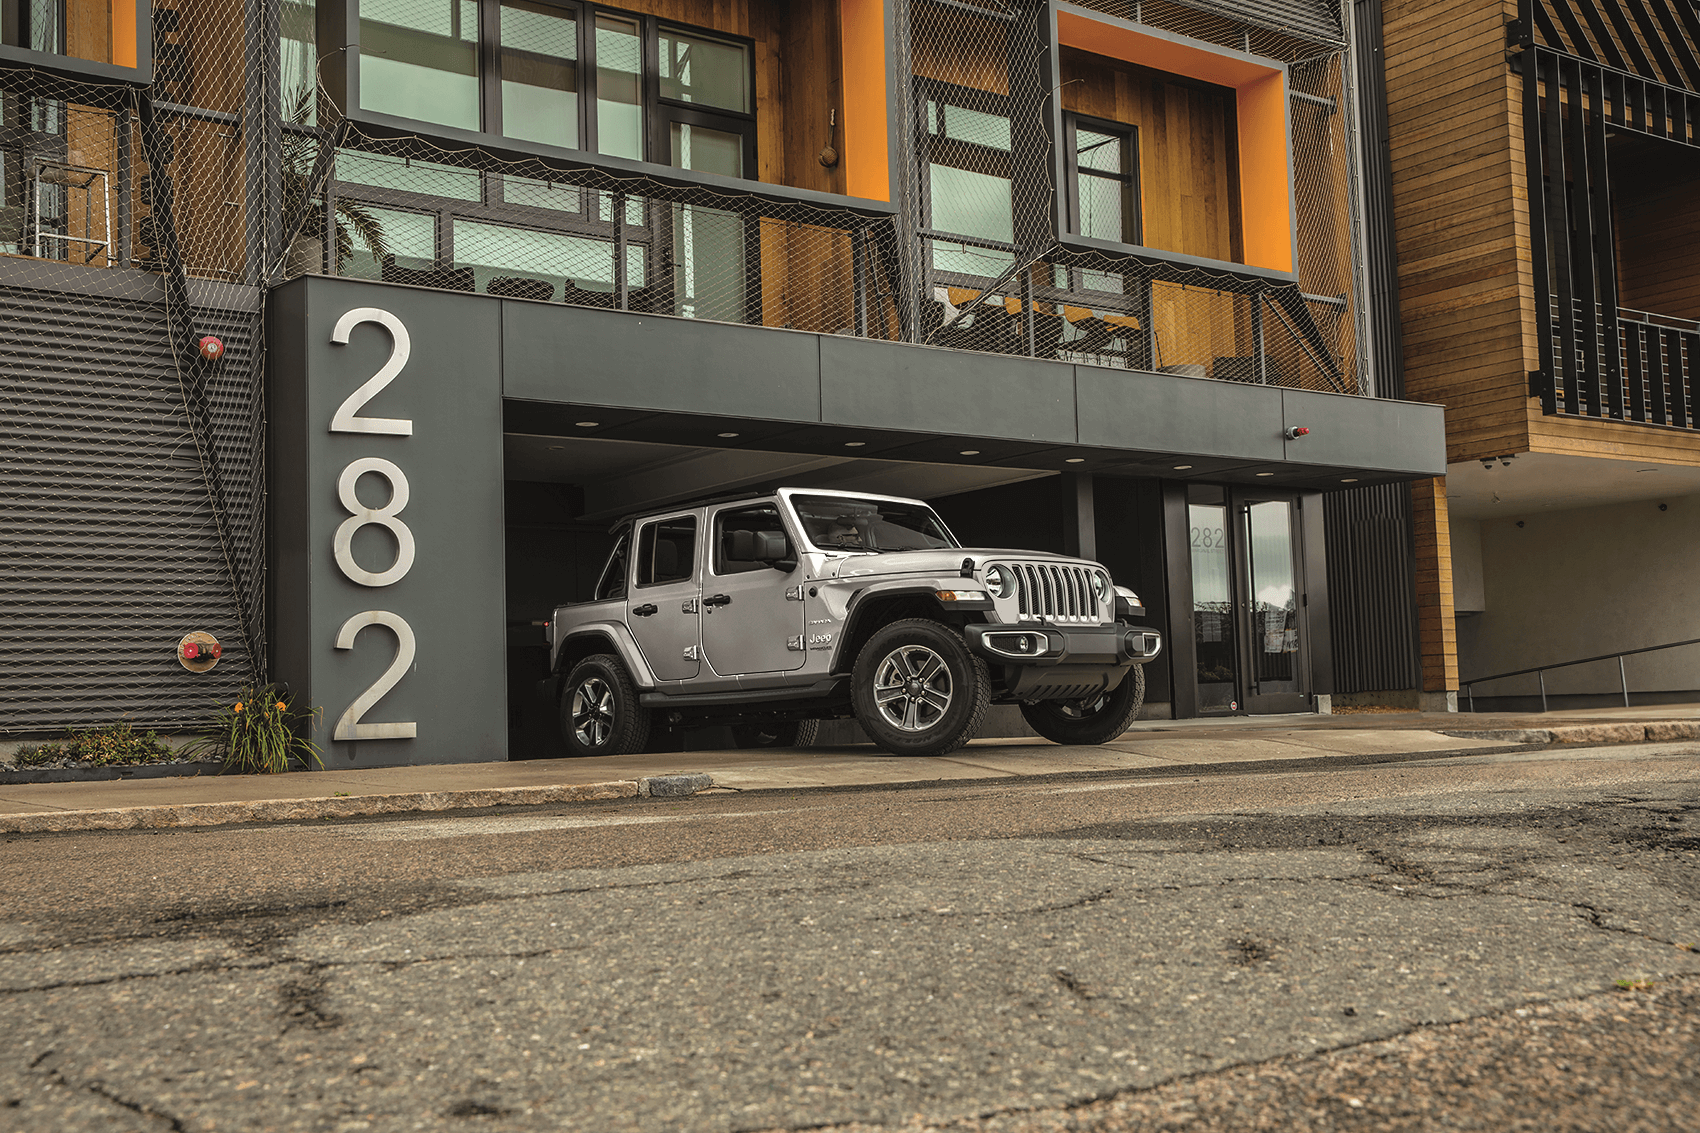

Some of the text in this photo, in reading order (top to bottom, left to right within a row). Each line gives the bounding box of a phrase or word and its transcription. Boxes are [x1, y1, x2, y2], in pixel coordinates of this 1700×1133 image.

[329, 306, 417, 742] 282
[1190, 526, 1225, 548] 282
[809, 633, 832, 645] Jeep
